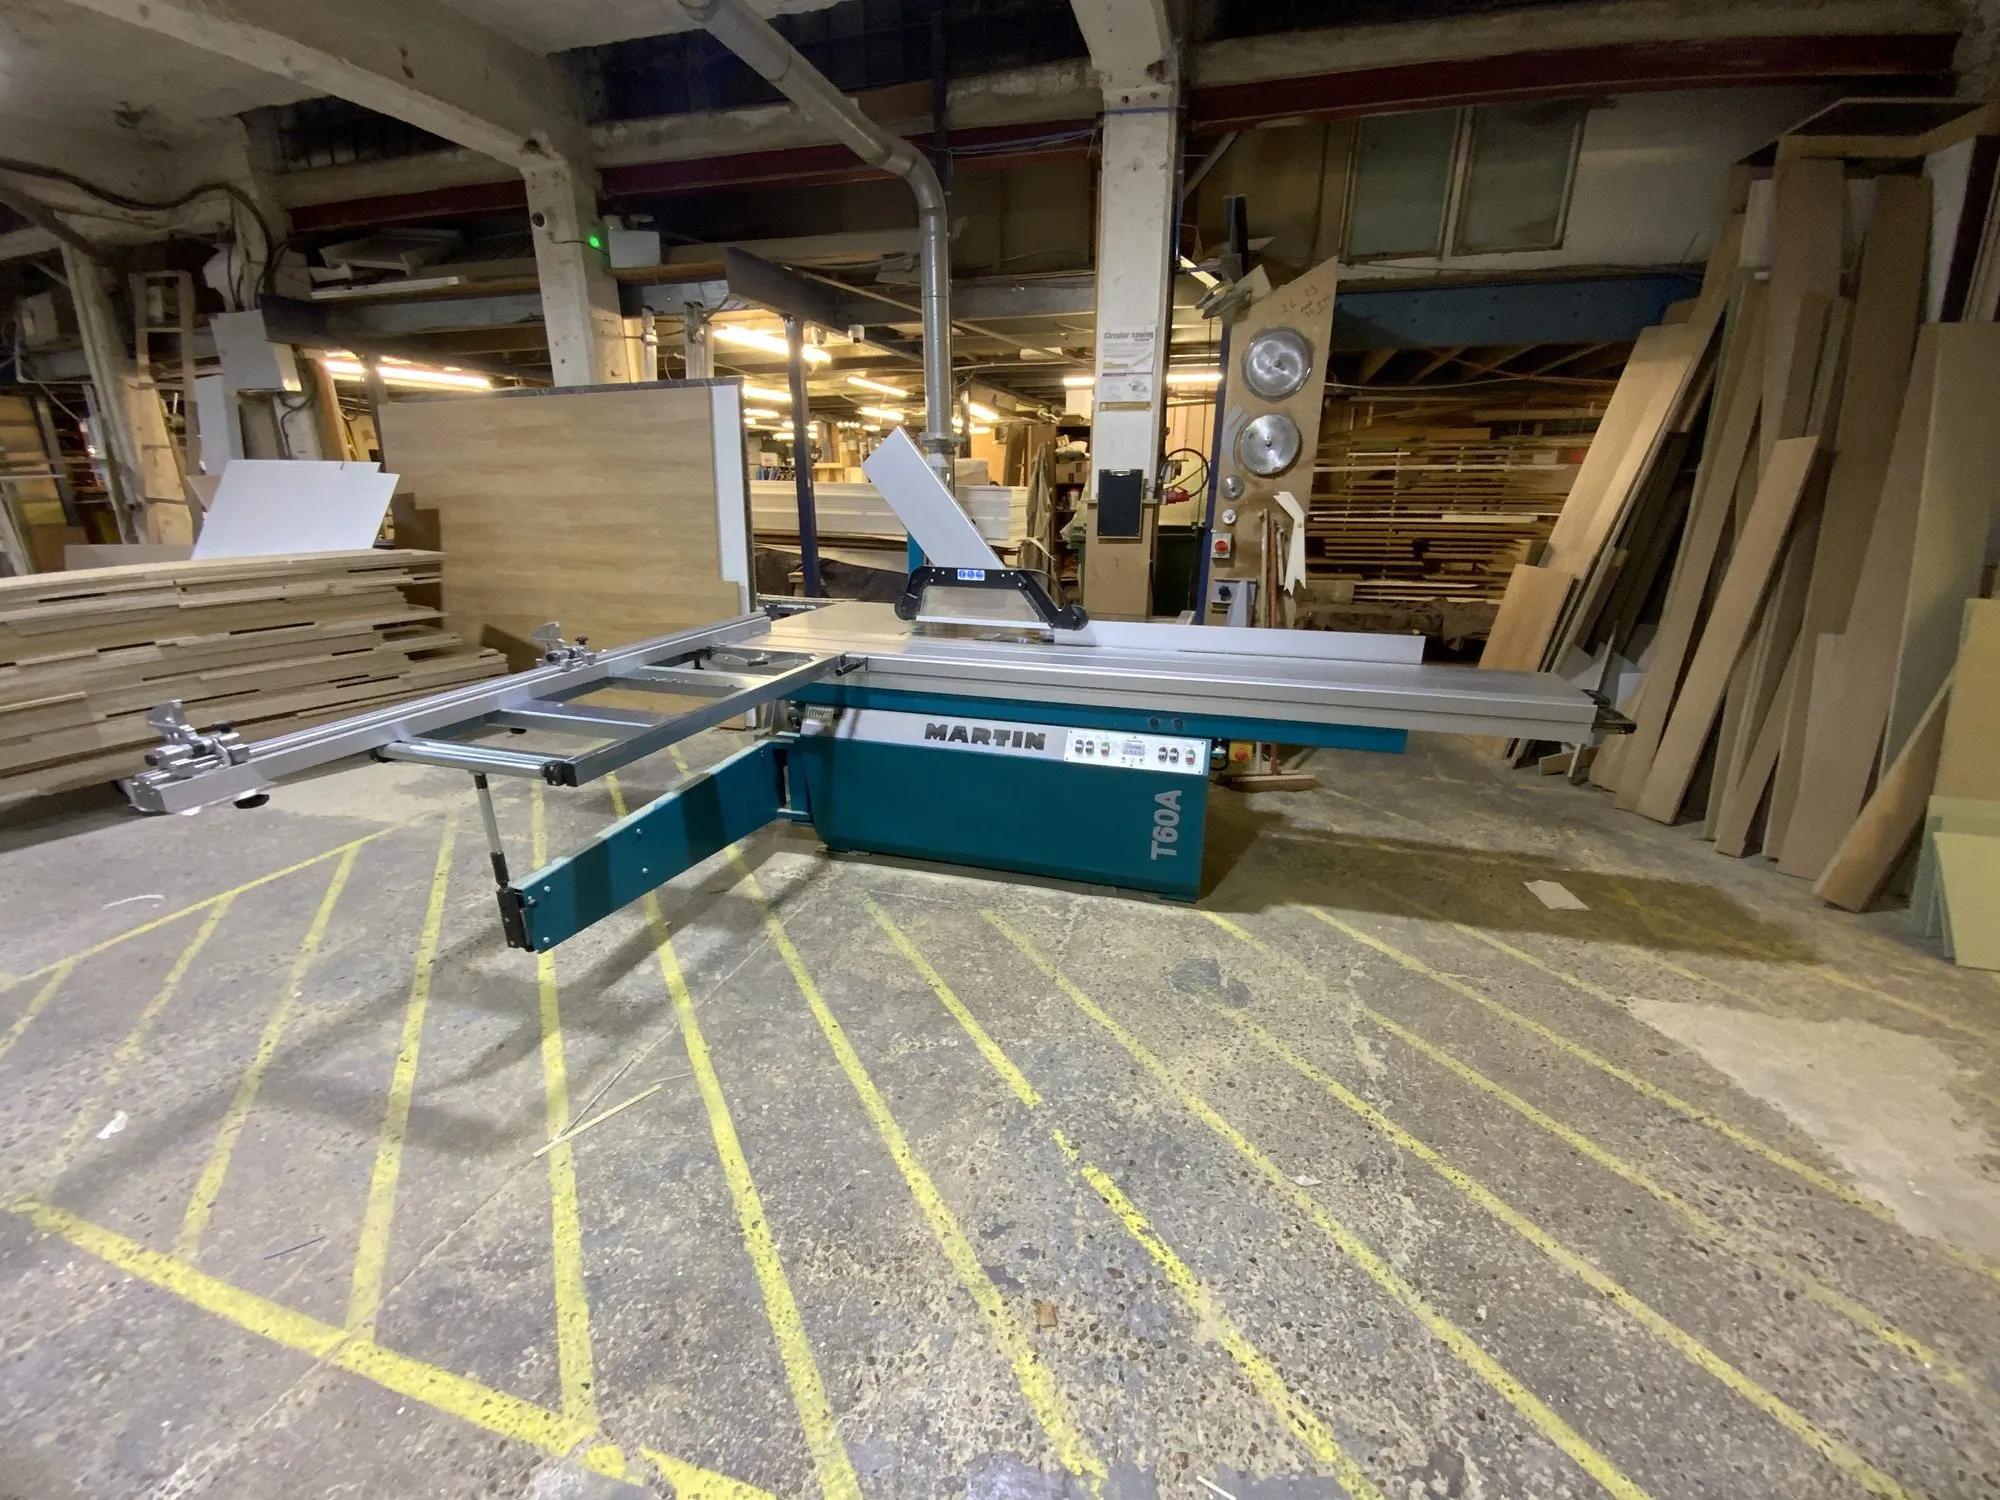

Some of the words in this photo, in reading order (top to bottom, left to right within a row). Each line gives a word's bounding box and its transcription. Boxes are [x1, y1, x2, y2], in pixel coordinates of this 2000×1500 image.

[1104, 331, 1129, 340] Circular
[1131, 331, 1154, 339] sawing
[924, 723, 1046, 750] MARTIN
[1150, 790, 1182, 860] T60A
